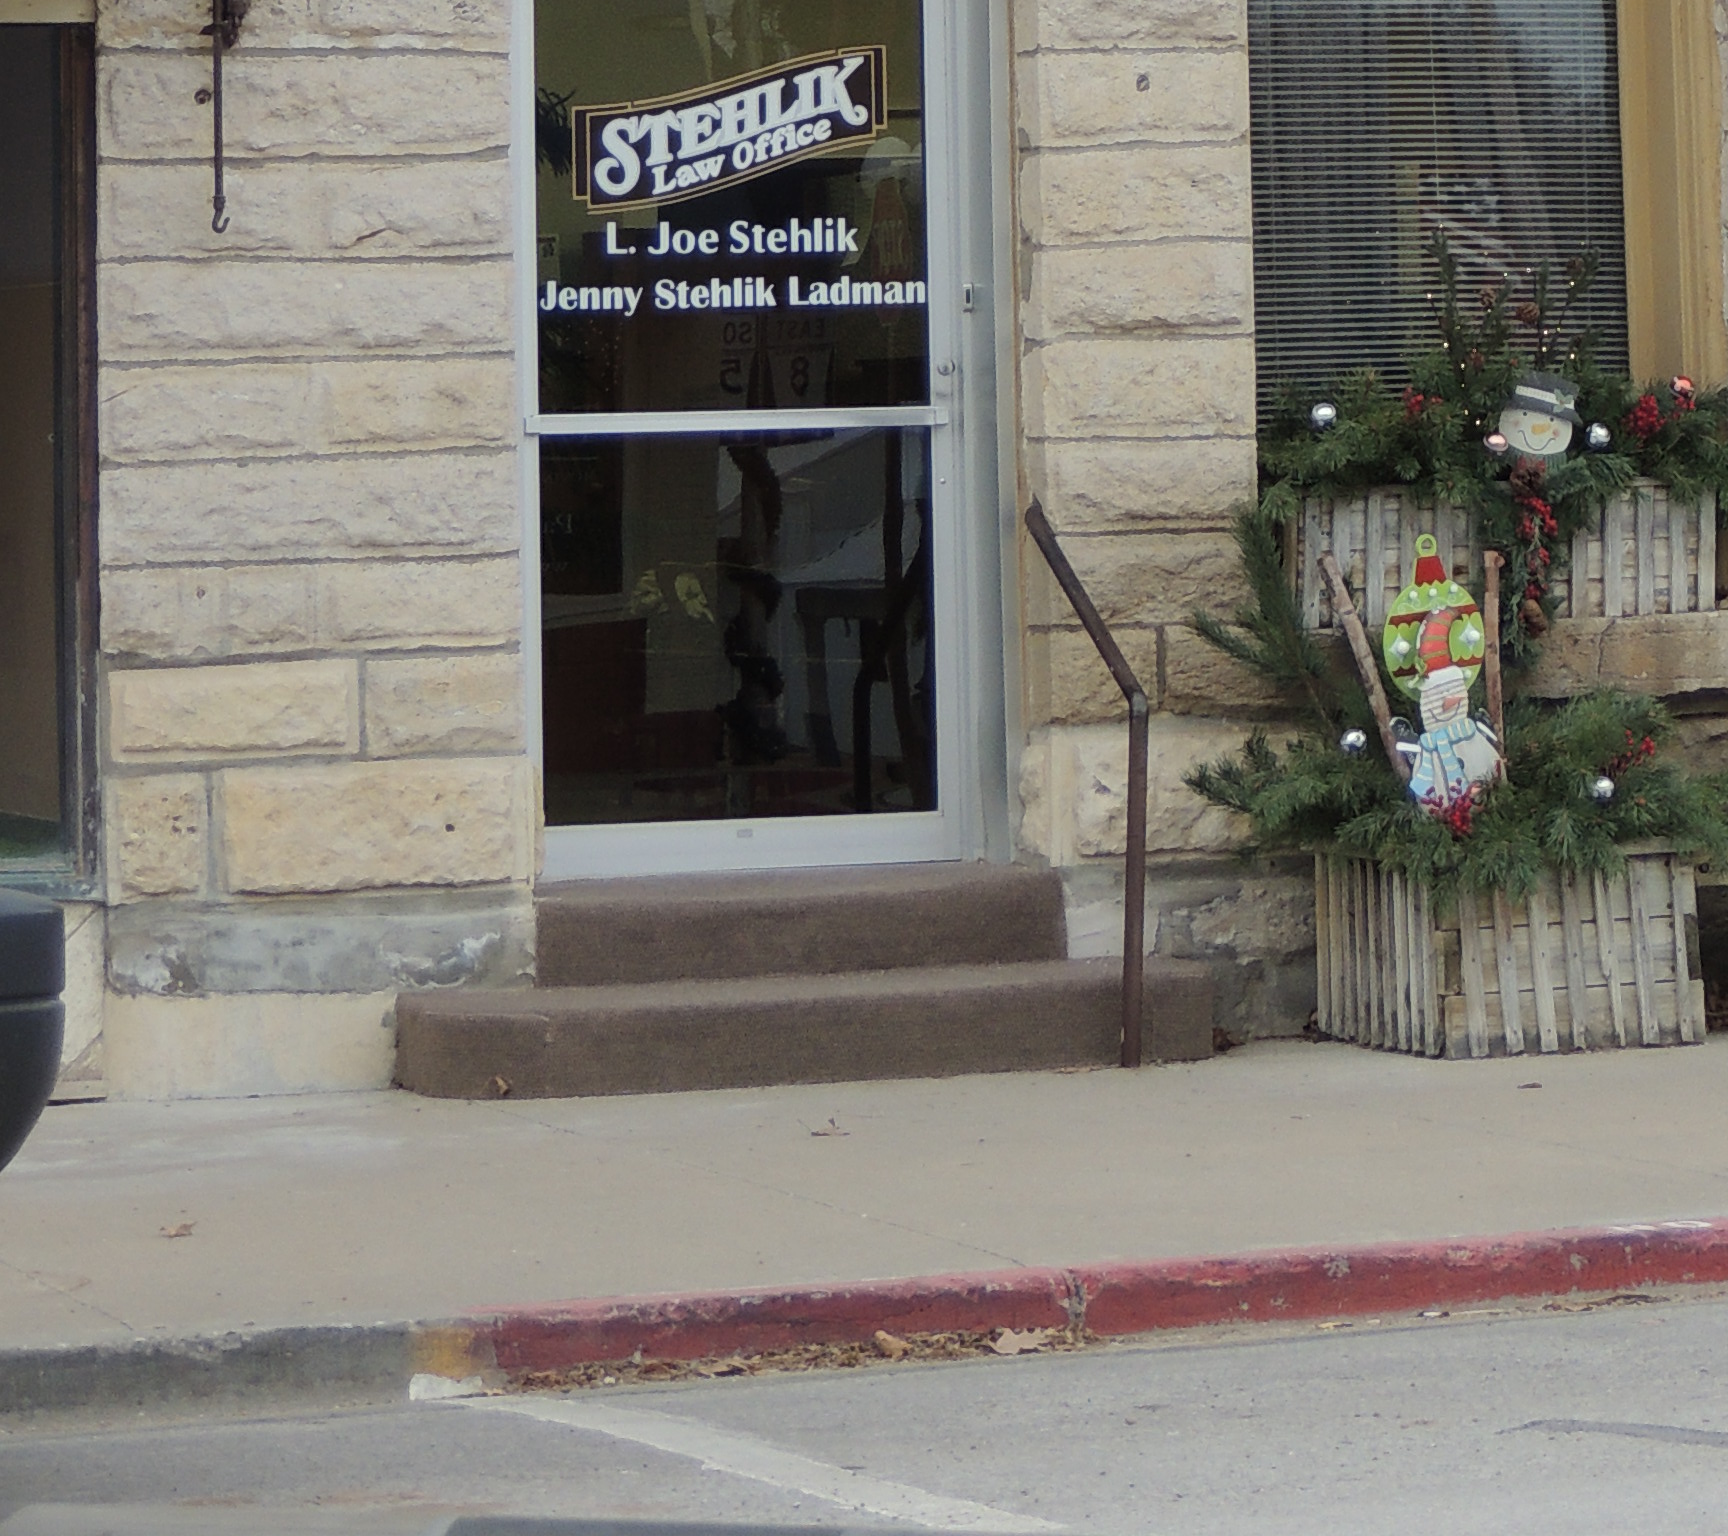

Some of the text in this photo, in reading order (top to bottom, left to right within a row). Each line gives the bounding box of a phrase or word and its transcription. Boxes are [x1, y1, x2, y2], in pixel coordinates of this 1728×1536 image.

[594, 56, 869, 197] STEHLIK
[651, 117, 832, 195] Law Office
[606, 217, 859, 255] L. Joe Stehlik
[540, 275, 926, 316] Jenny Stehlik Ladman
